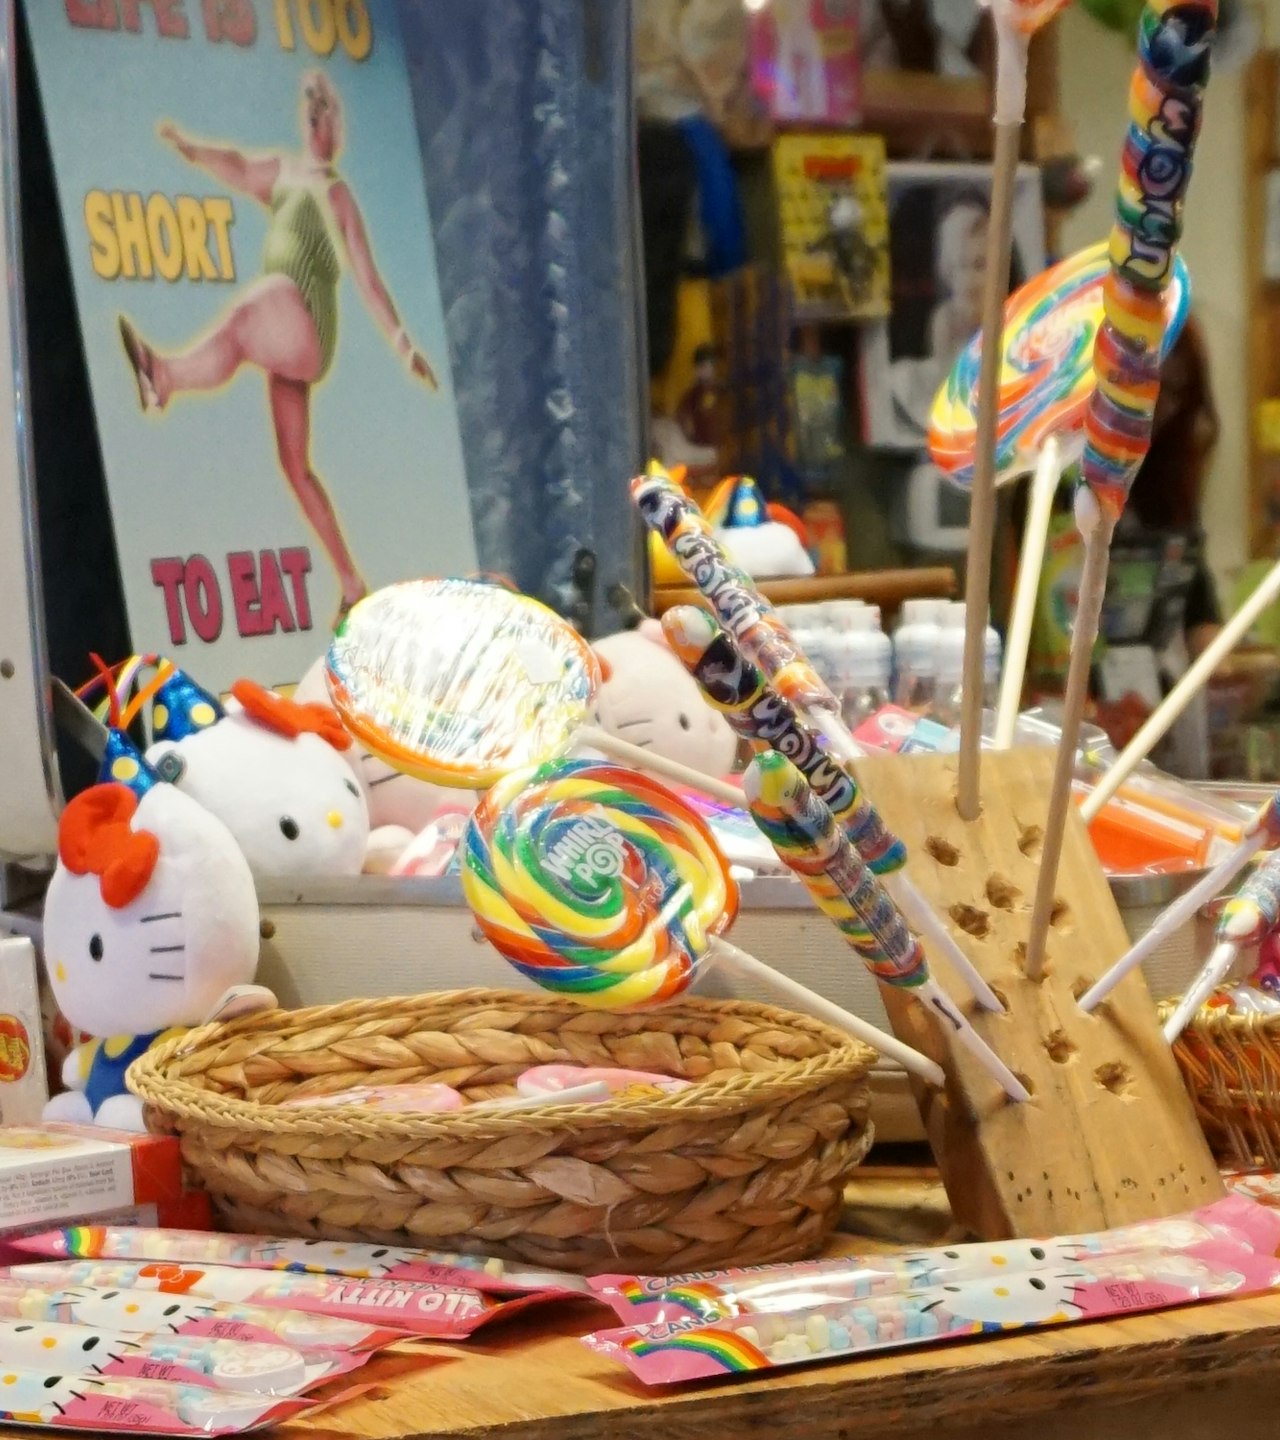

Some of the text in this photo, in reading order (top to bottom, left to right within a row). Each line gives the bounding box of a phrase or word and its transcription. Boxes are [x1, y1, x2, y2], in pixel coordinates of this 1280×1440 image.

[83, 189, 237, 284] SHORT
[151, 545, 312, 646] TO EAT
[646, 1267, 729, 1293] CANDY
